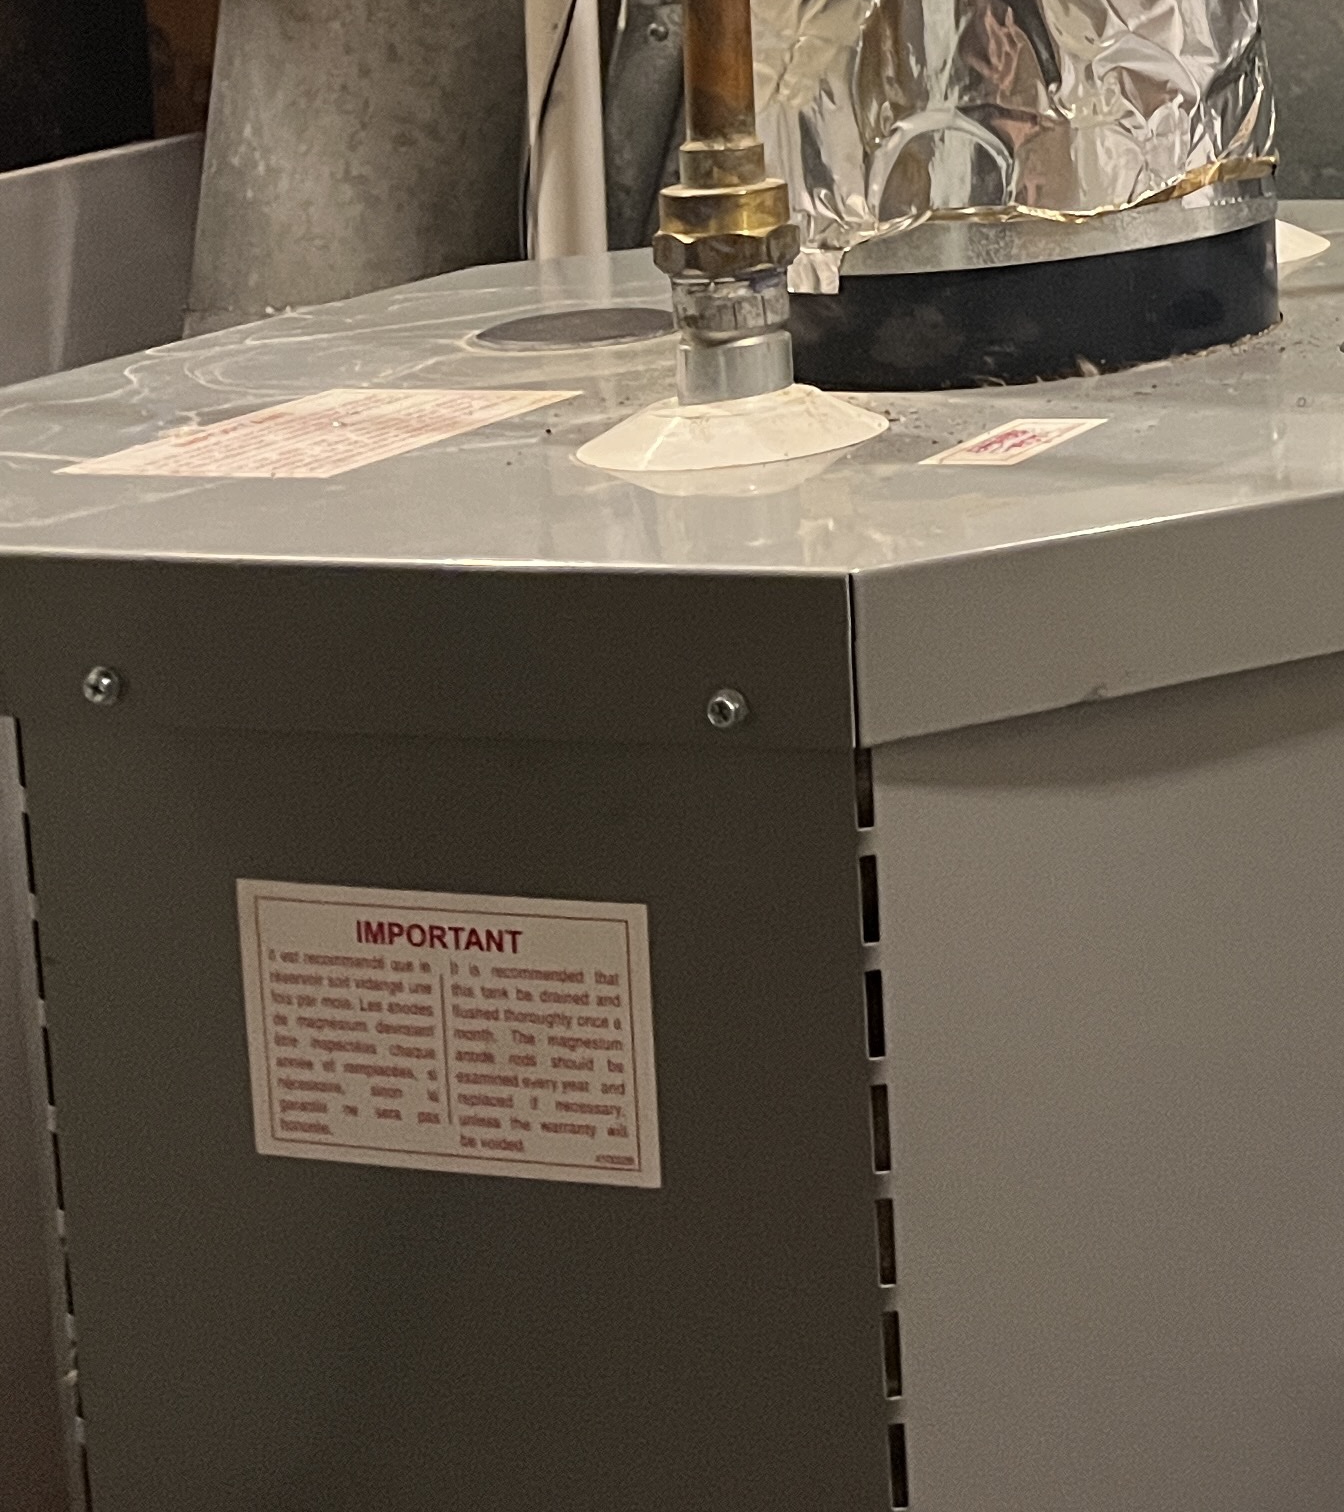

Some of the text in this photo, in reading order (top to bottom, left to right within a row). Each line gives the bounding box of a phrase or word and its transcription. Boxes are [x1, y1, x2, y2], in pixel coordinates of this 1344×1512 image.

[356, 920, 523, 954] IMPORTANT
[491, 967, 584, 984] recommended
[504, 1008, 572, 1029] thoroughly
[547, 1035, 623, 1051] magnesium
